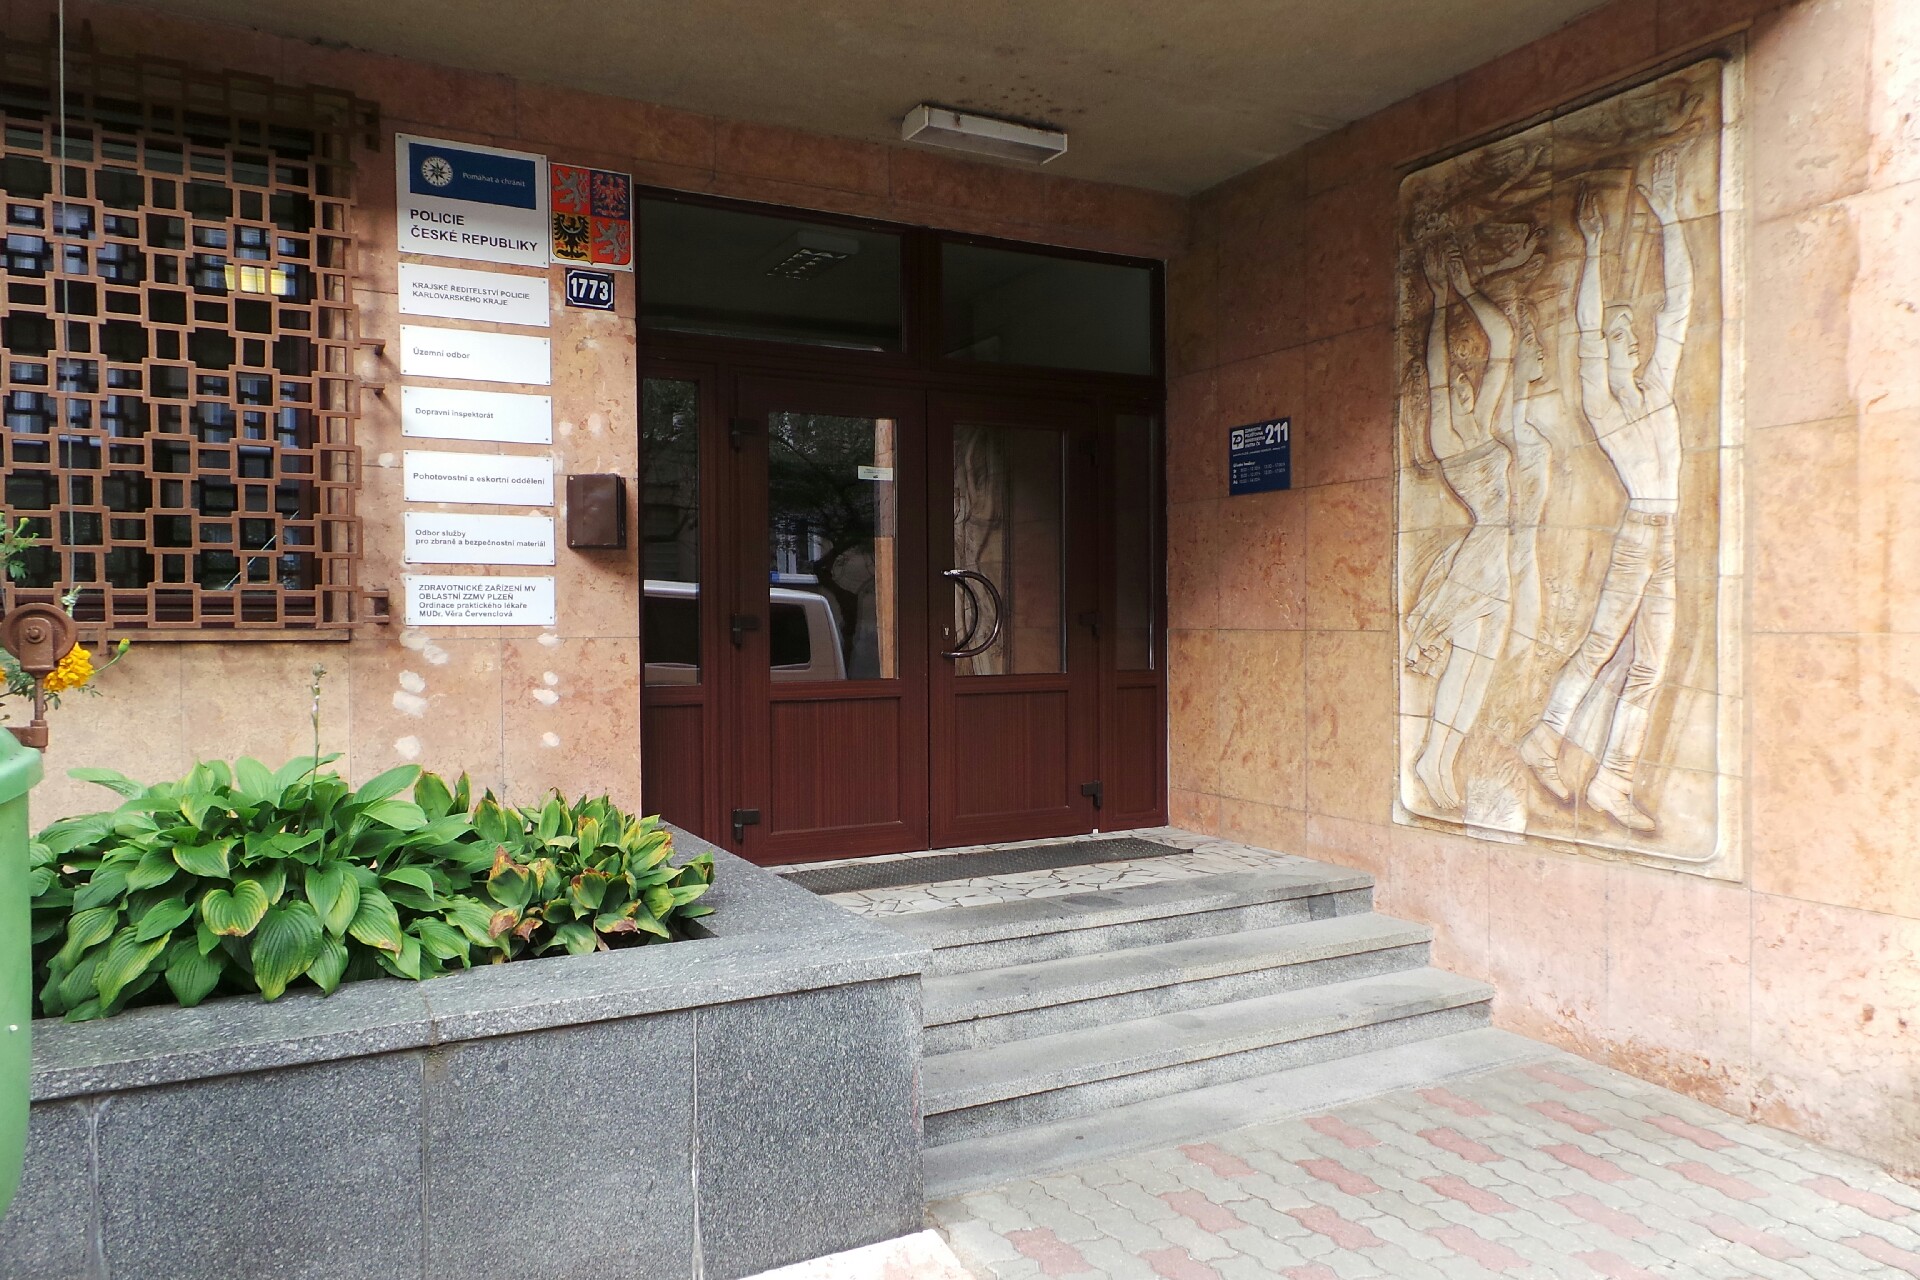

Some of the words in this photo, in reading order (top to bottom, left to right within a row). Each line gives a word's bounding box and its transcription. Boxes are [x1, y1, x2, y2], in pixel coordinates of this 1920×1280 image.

[462, 172, 494, 183] Pomáhat
[501, 177, 526, 187] chránit
[410, 209, 465, 226] POLICIE
[410, 225, 458, 242] ČESKÉ
[462, 233, 538, 252] REPUBLIKY
[412, 281, 449, 291] KRAJSKÉ
[500, 290, 530, 300] POLICIE
[571, 277, 609, 301] 1773
[412, 290, 481, 303] KARLOVARSKÉHO
[483, 297, 508, 306] KRAJE
[413, 346, 444, 357] Územní
[446, 350, 470, 359] odbor
[415, 407, 450, 416] Dopravní
[451, 409, 494, 419] inspektorát
[1265, 421, 1288, 445] 211
[413, 472, 468, 482] Pohotovostní
[476, 475, 509, 484] eskortní
[511, 476, 545, 485] oddělení
[441, 530, 466, 538] služby
[431, 537, 456, 545] zbraně
[464, 539, 515, 547] bezpečnostní
[418, 583, 483, 591] ZDRAVOTNICKÉ
[484, 582, 523, 592] ZAŘÍZENÍ
[418, 592, 461, 600] OBLASTNÍ
[487, 592, 514, 600] PLZEŇ
[419, 601, 455, 609] Ordinace
[456, 601, 502, 610] praktického
